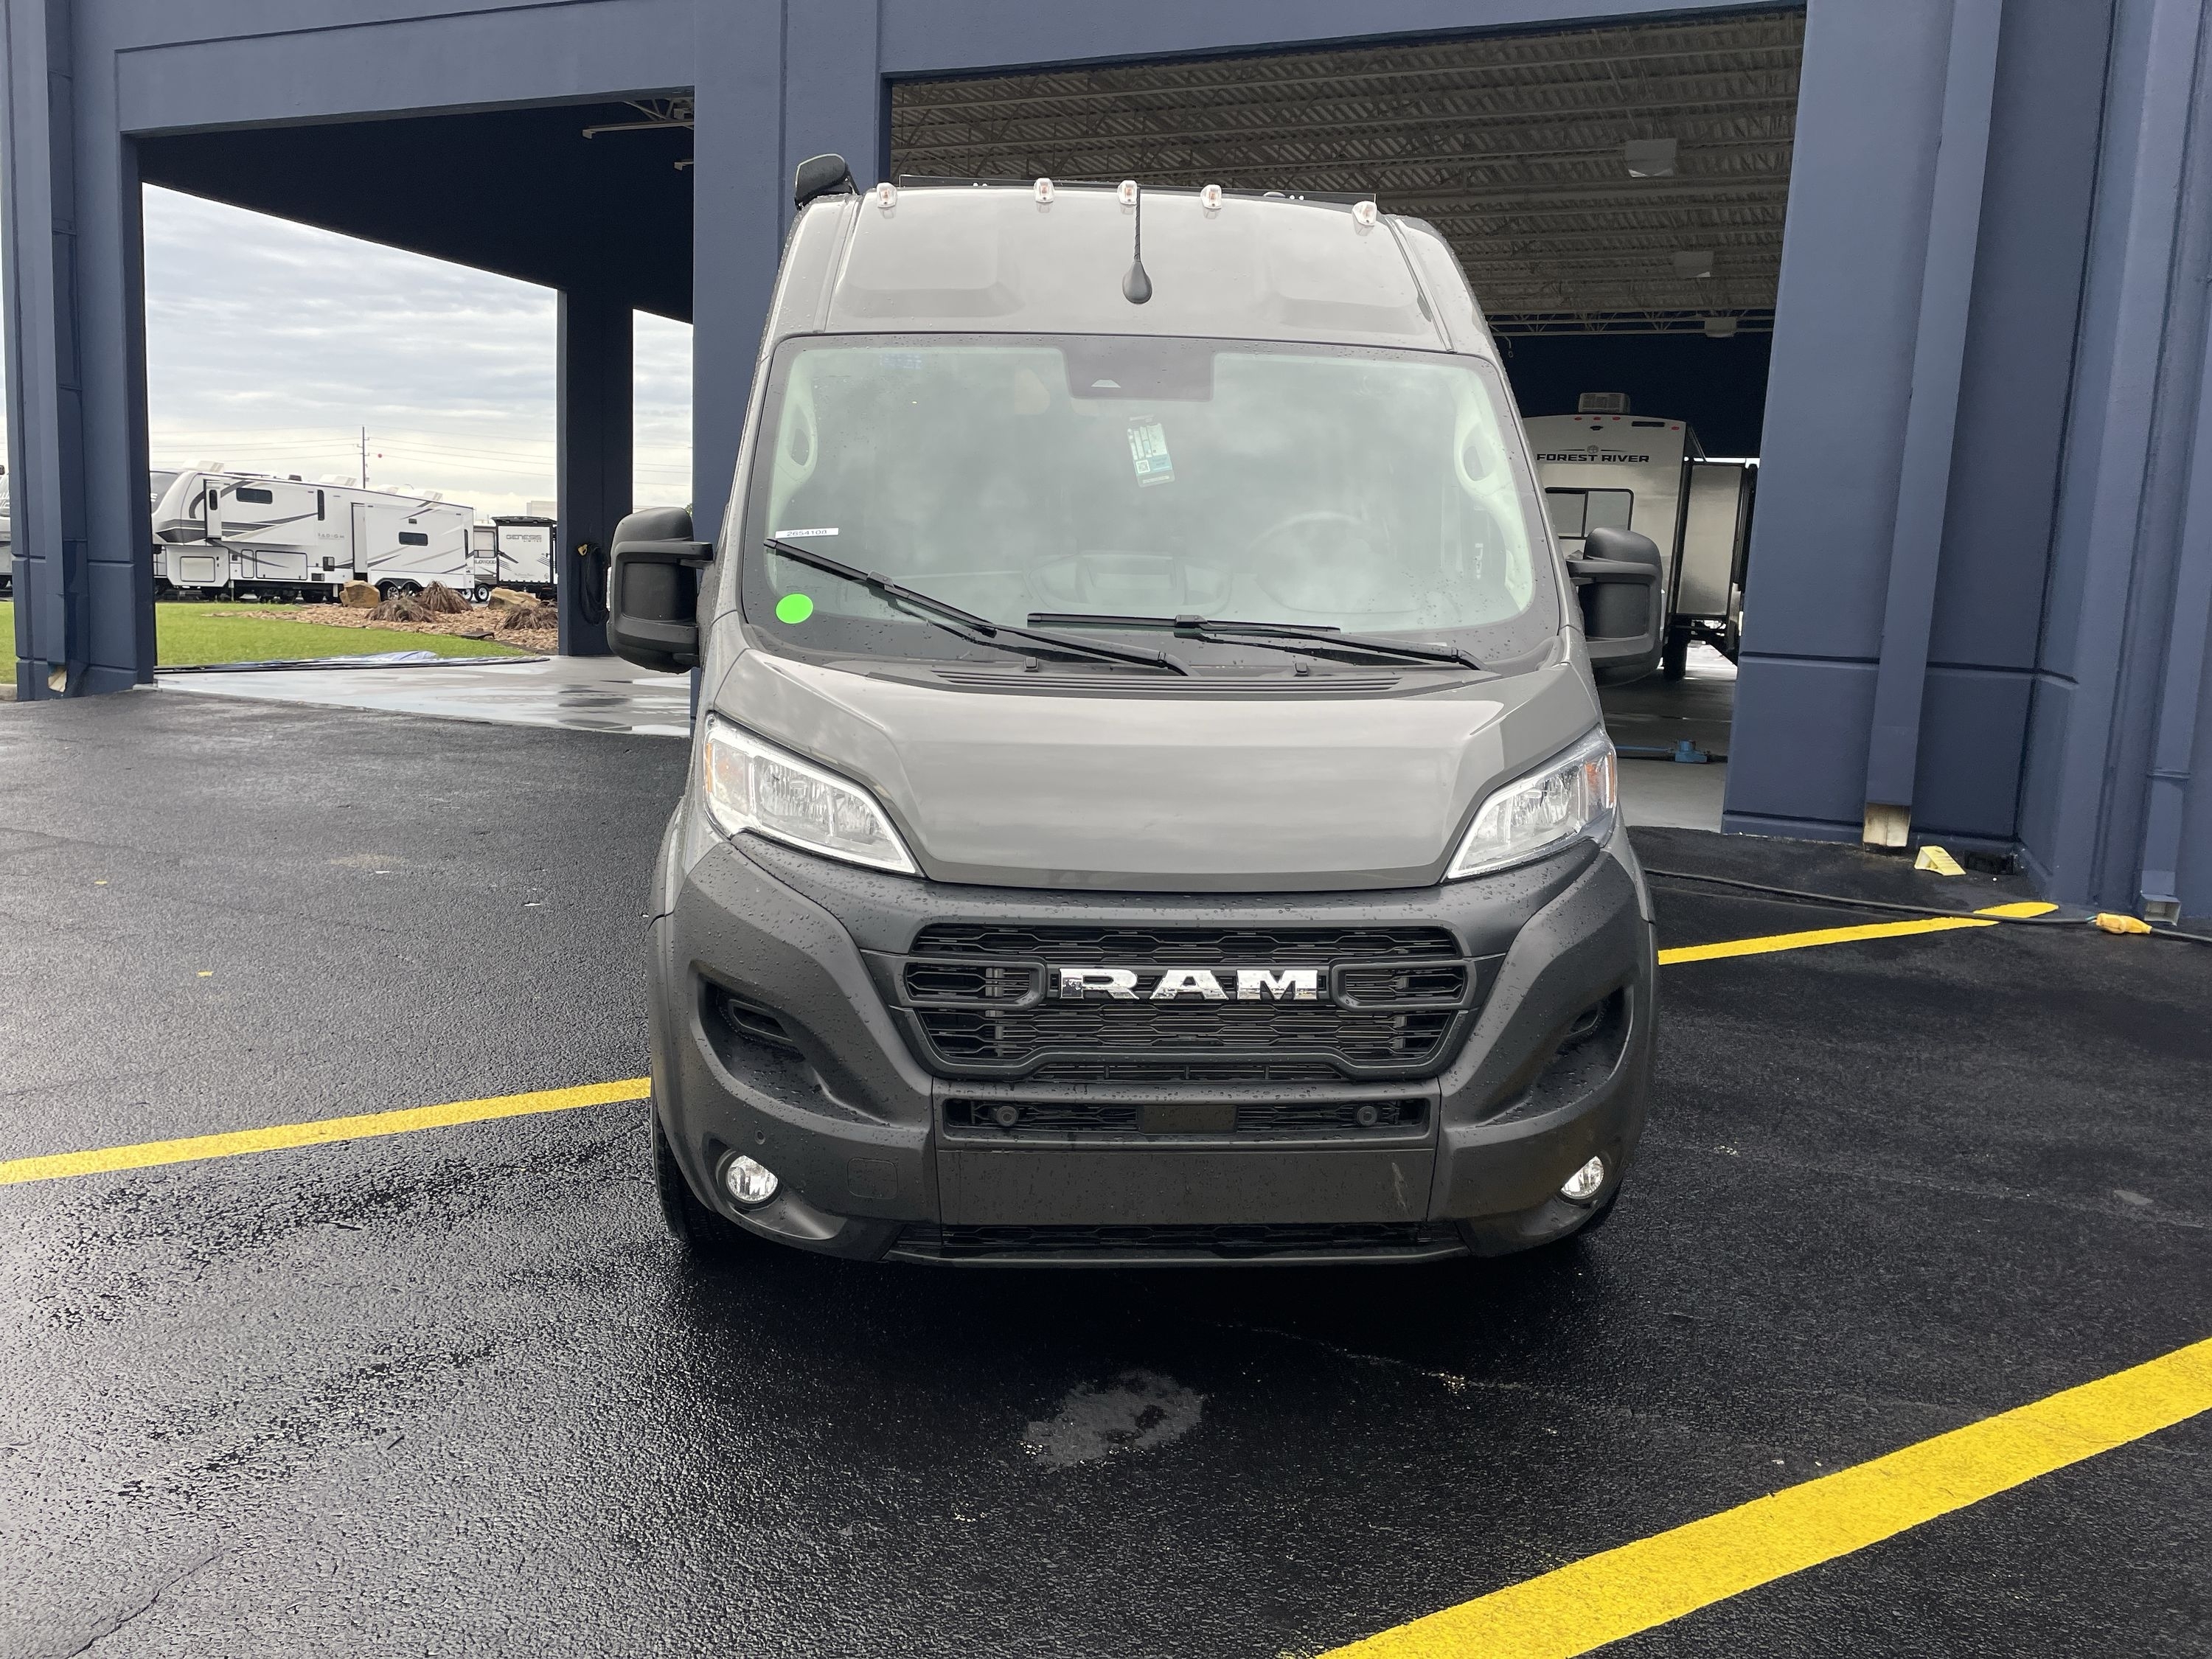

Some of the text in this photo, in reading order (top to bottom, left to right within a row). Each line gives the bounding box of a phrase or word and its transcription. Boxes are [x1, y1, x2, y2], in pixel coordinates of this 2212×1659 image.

[1537, 453, 1649, 462] FOREST RIVER
[1060, 968, 1318, 1001] RAM
